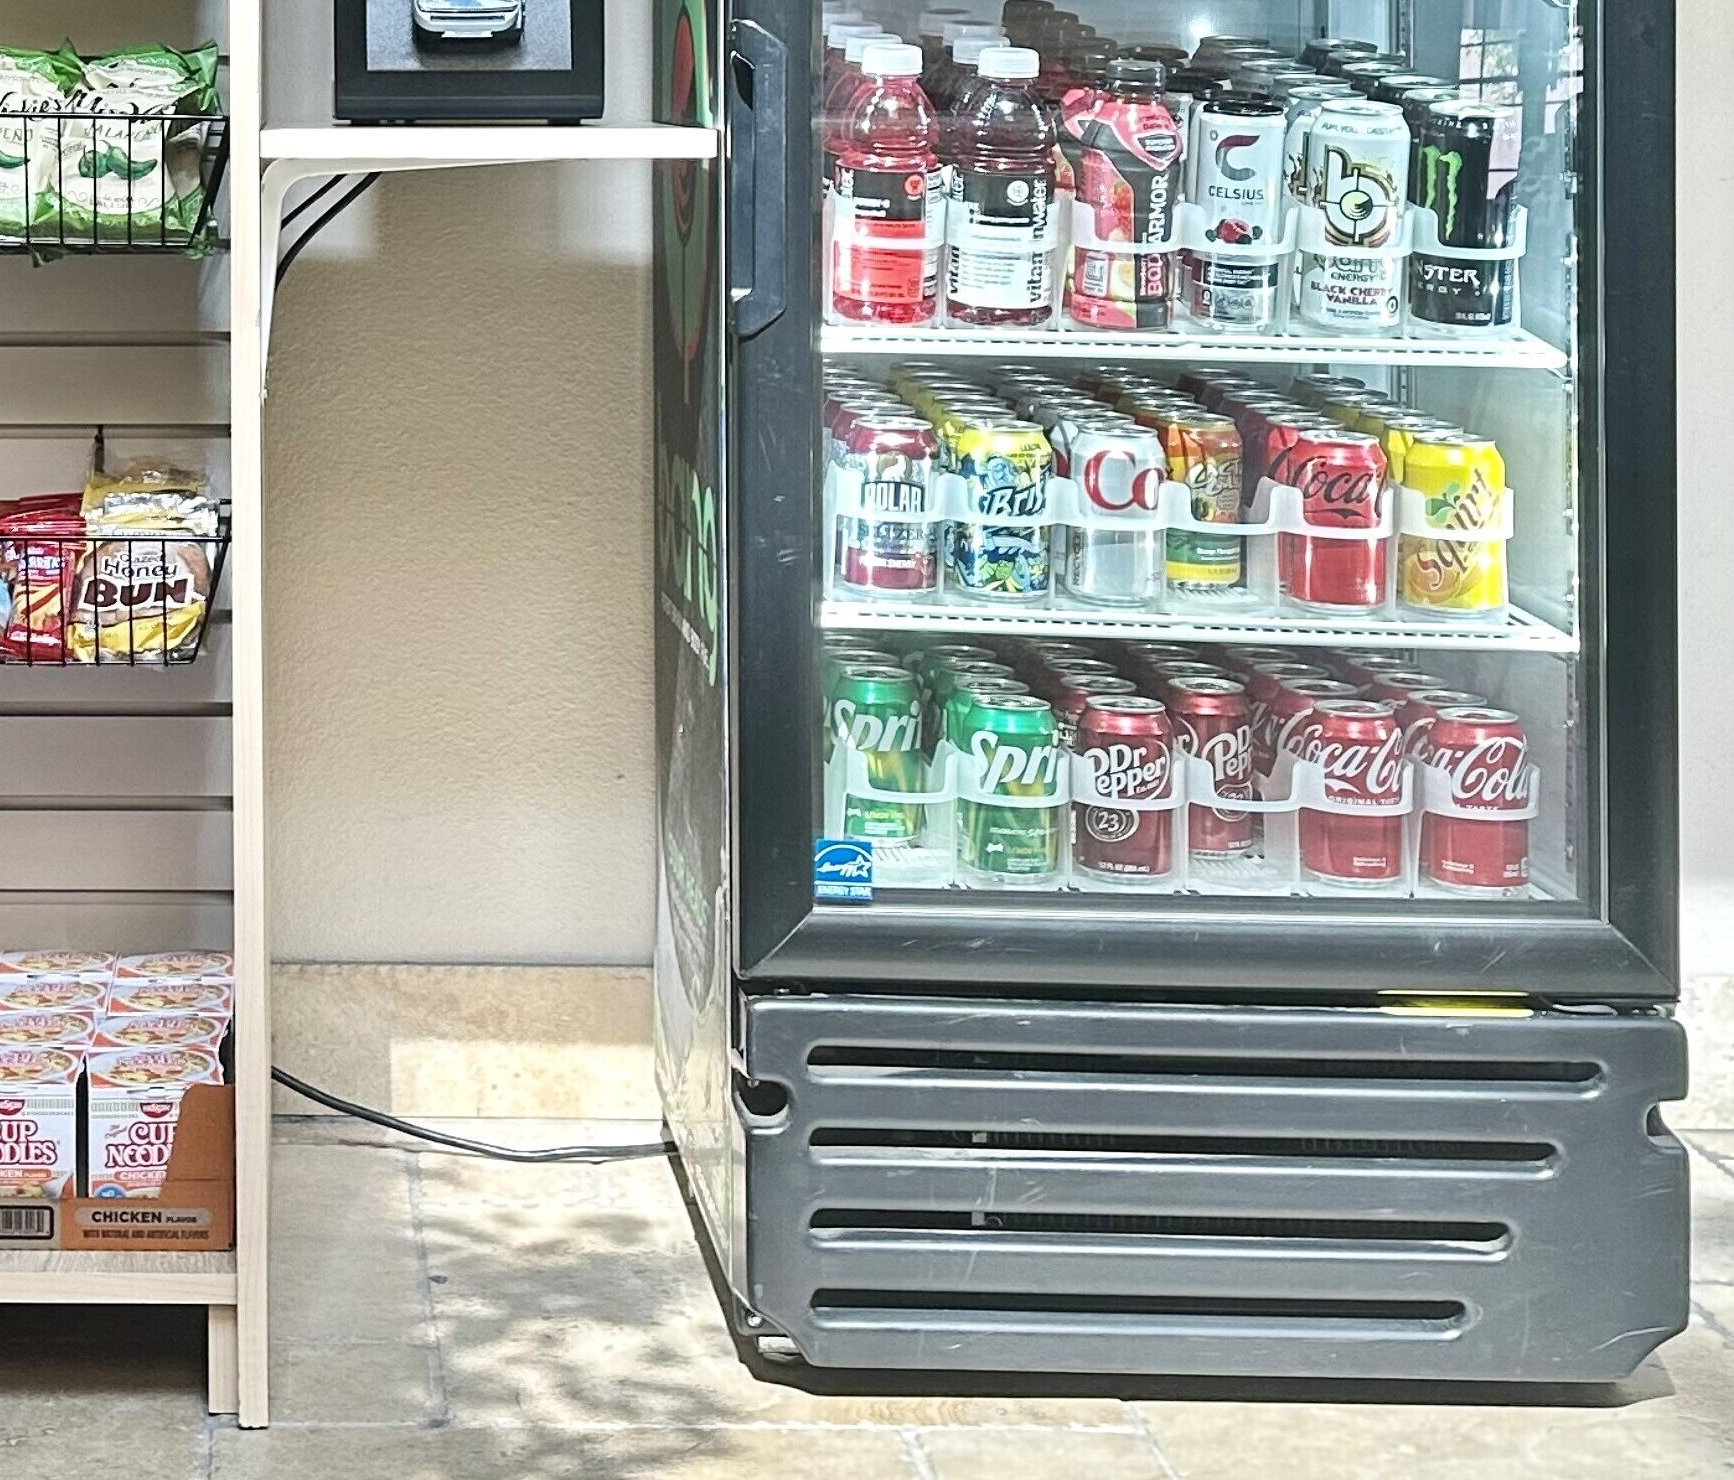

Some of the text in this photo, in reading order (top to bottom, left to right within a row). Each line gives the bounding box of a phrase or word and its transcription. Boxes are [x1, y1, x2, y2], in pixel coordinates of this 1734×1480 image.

[1208, 185, 1264, 200] CELSIUS
[1311, 281, 1393, 297] BLACK CHERRY
[1326, 294, 1378, 306] VANILLA
[866, 482, 922, 513] POLAR
[1416, 466, 1494, 592] Squirt
[104, 556, 179, 578] Honey
[83, 578, 189, 608] BUN
[1108, 743, 1148, 774] Dr
[1098, 811, 1120, 831] 23
[817, 887, 849, 897] ENERGY
[91, 1210, 162, 1224] CHICKEN
